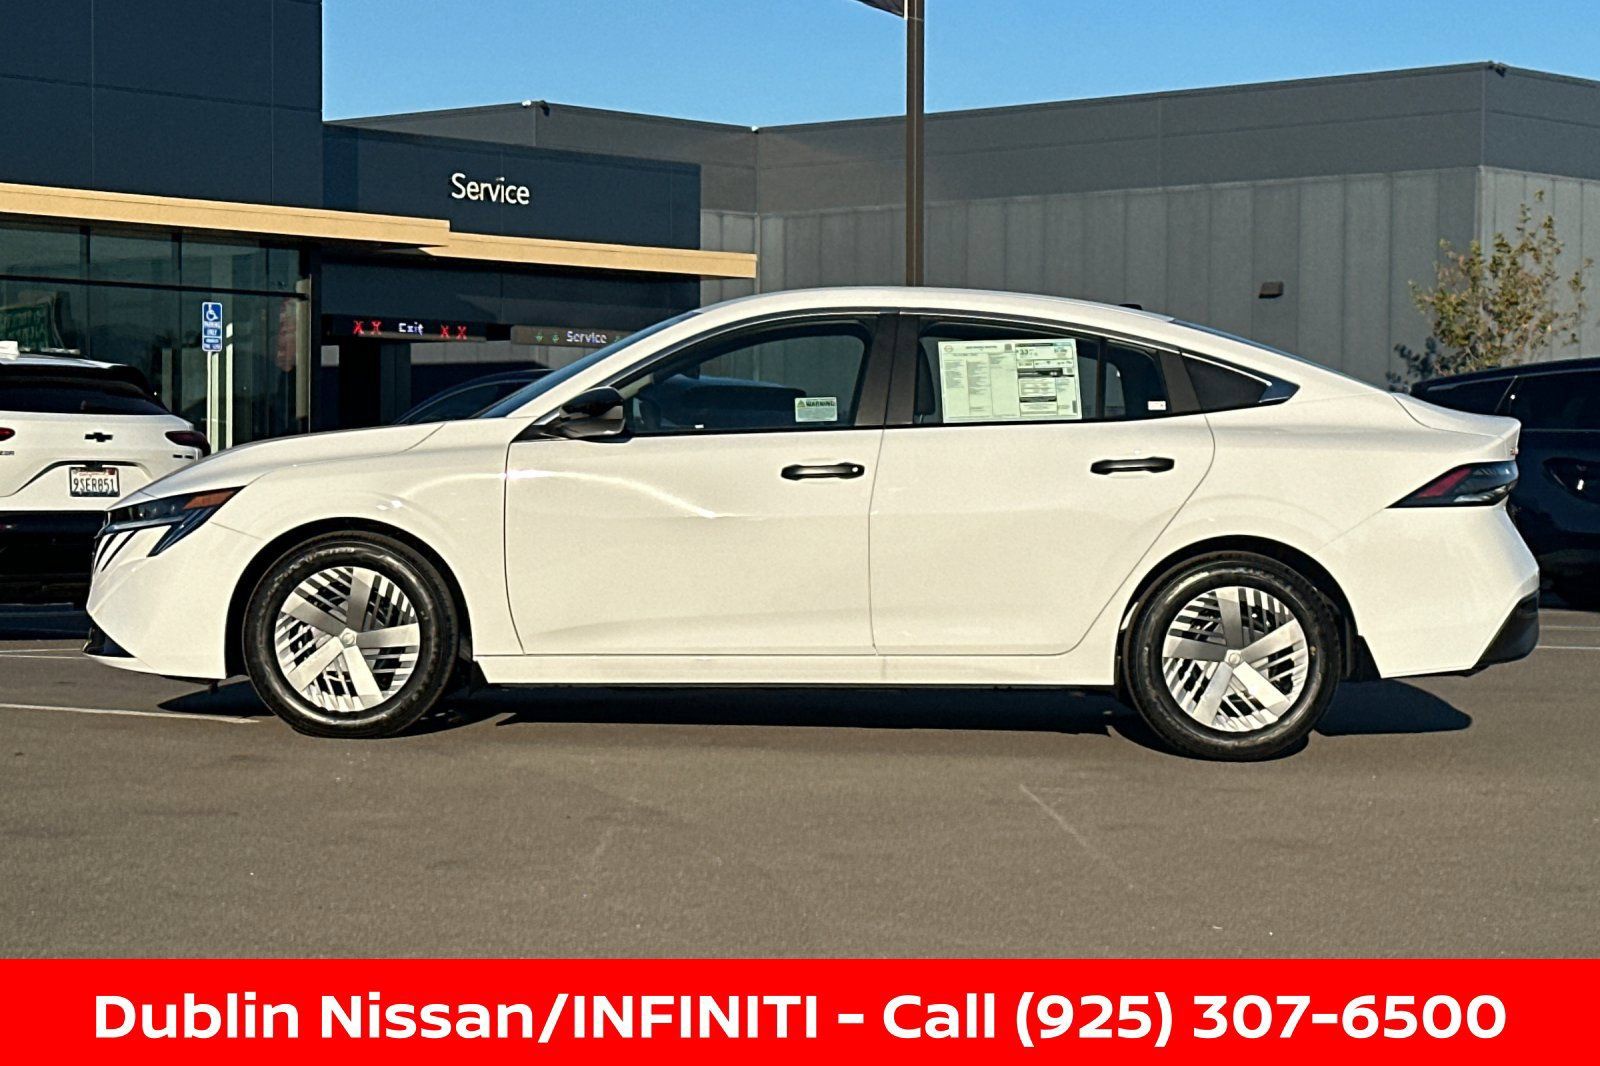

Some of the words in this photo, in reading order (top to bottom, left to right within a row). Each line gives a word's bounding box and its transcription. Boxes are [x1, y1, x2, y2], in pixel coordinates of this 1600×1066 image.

[451, 172, 531, 205] Service
[398, 321, 424, 336] Exit
[566, 330, 607, 344] Service
